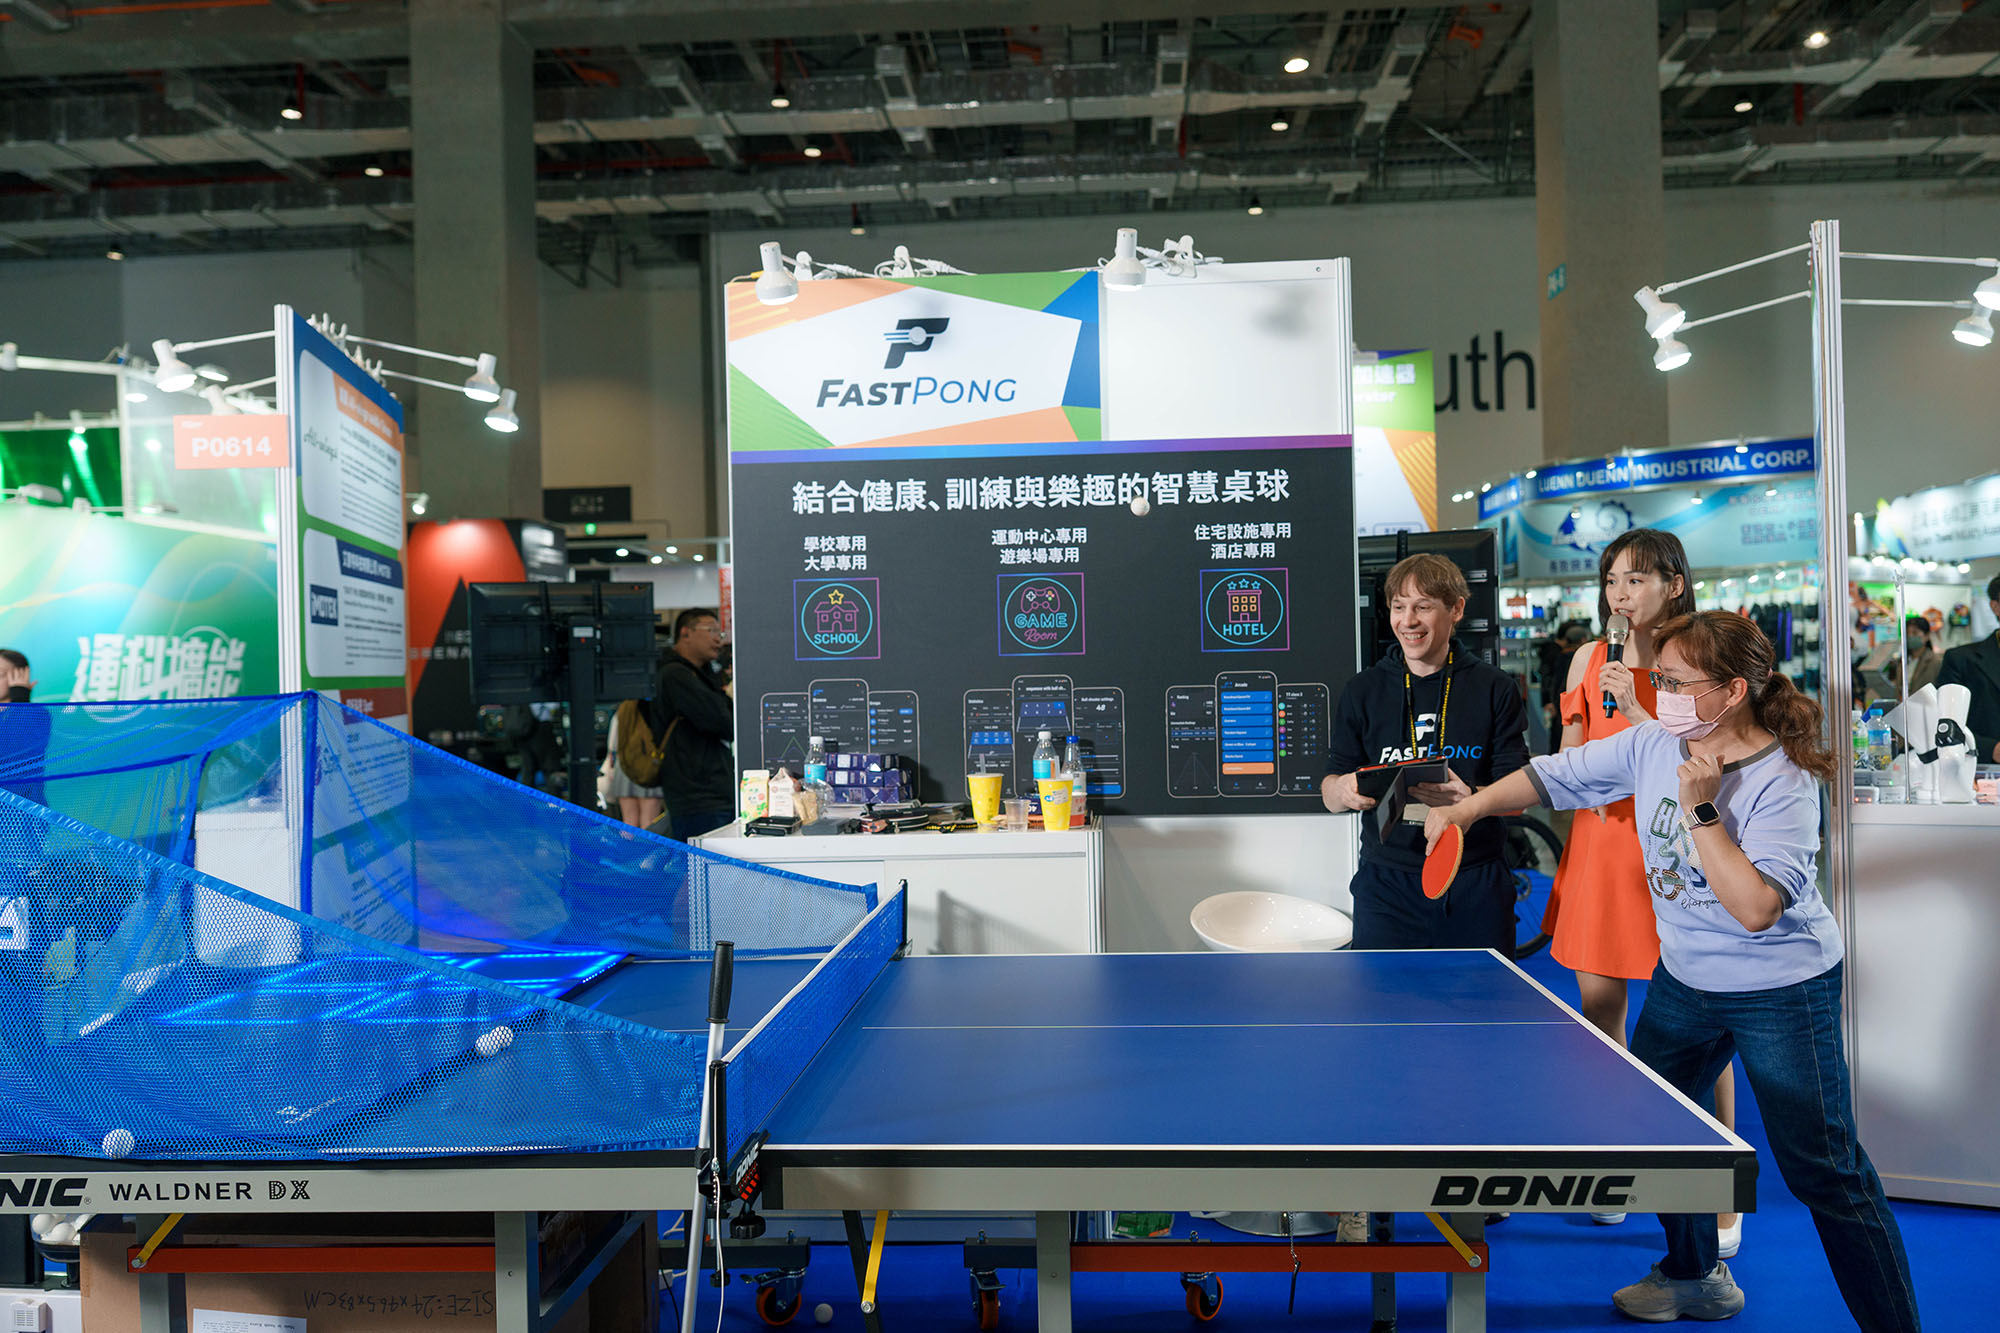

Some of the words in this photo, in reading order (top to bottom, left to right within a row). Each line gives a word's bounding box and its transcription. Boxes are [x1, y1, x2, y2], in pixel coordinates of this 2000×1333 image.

[191, 436, 272, 457] P0614
[1538, 472, 1575, 492] LUENN
[1577, 466, 1629, 488] DUENN
[1632, 454, 1746, 481] INDUSTRIAL
[1751, 449, 1812, 470] CORP.
[792, 469, 1290, 515] 結合健康、訓練與樂趣的智慧桌球
[991, 527, 1088, 546] 運動中心專用
[1194, 522, 1292, 541] 住宅設施專用
[804, 535, 867, 552] 學校專用
[1210, 542, 1276, 560] 酒店專用
[804, 554, 867, 571] 大學專用
[1000, 547, 1080, 565] 遊樂場專用
[1014, 612, 1068, 629] GAME
[1222, 623, 1267, 636] HOTEL
[814, 633, 861, 645] SCHOOL
[1024, 628, 1057, 642] Room
[0, 1178, 88, 1207] NIC
[109, 1182, 253, 1201] WALDNER
[268, 1180, 311, 1200] DX
[1431, 1175, 1636, 1206] DONIC
